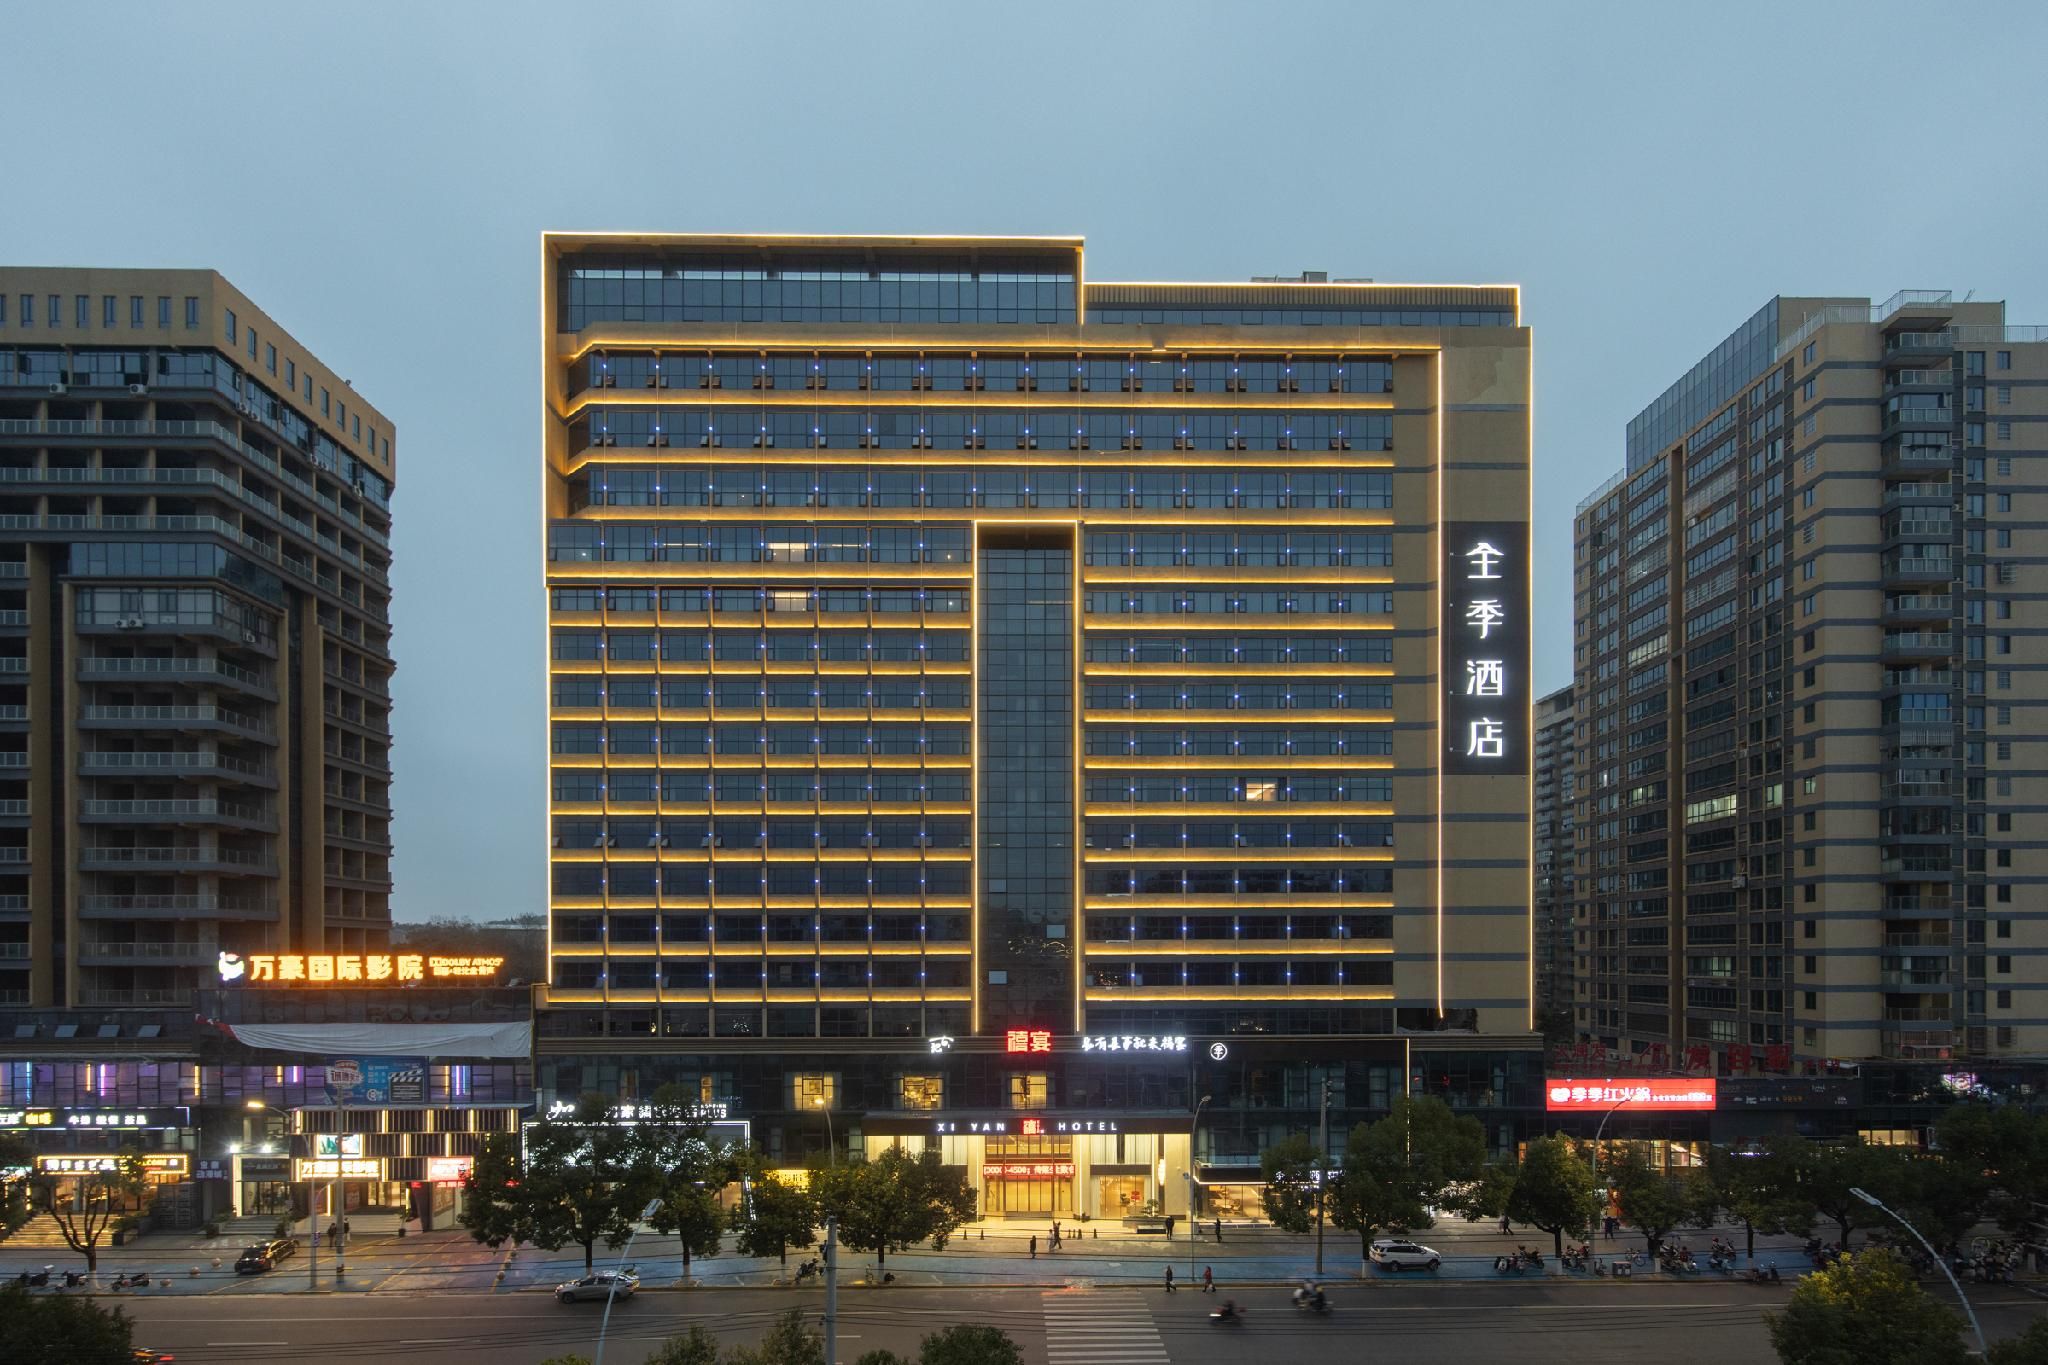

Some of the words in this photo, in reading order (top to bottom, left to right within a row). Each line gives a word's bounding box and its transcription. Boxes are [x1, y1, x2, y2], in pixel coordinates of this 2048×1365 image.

[1466, 542, 1504, 757] 全季酒店
[250, 954, 424, 981] 万豪国际影院
[1007, 1030, 1051, 1053] 禧宴
[1571, 1087, 1650, 1102] 季季红火锅
[937, 1122, 955, 1132] XI
[971, 1122, 1005, 1132] YAN
[1058, 1122, 1117, 1131] HOTEL
